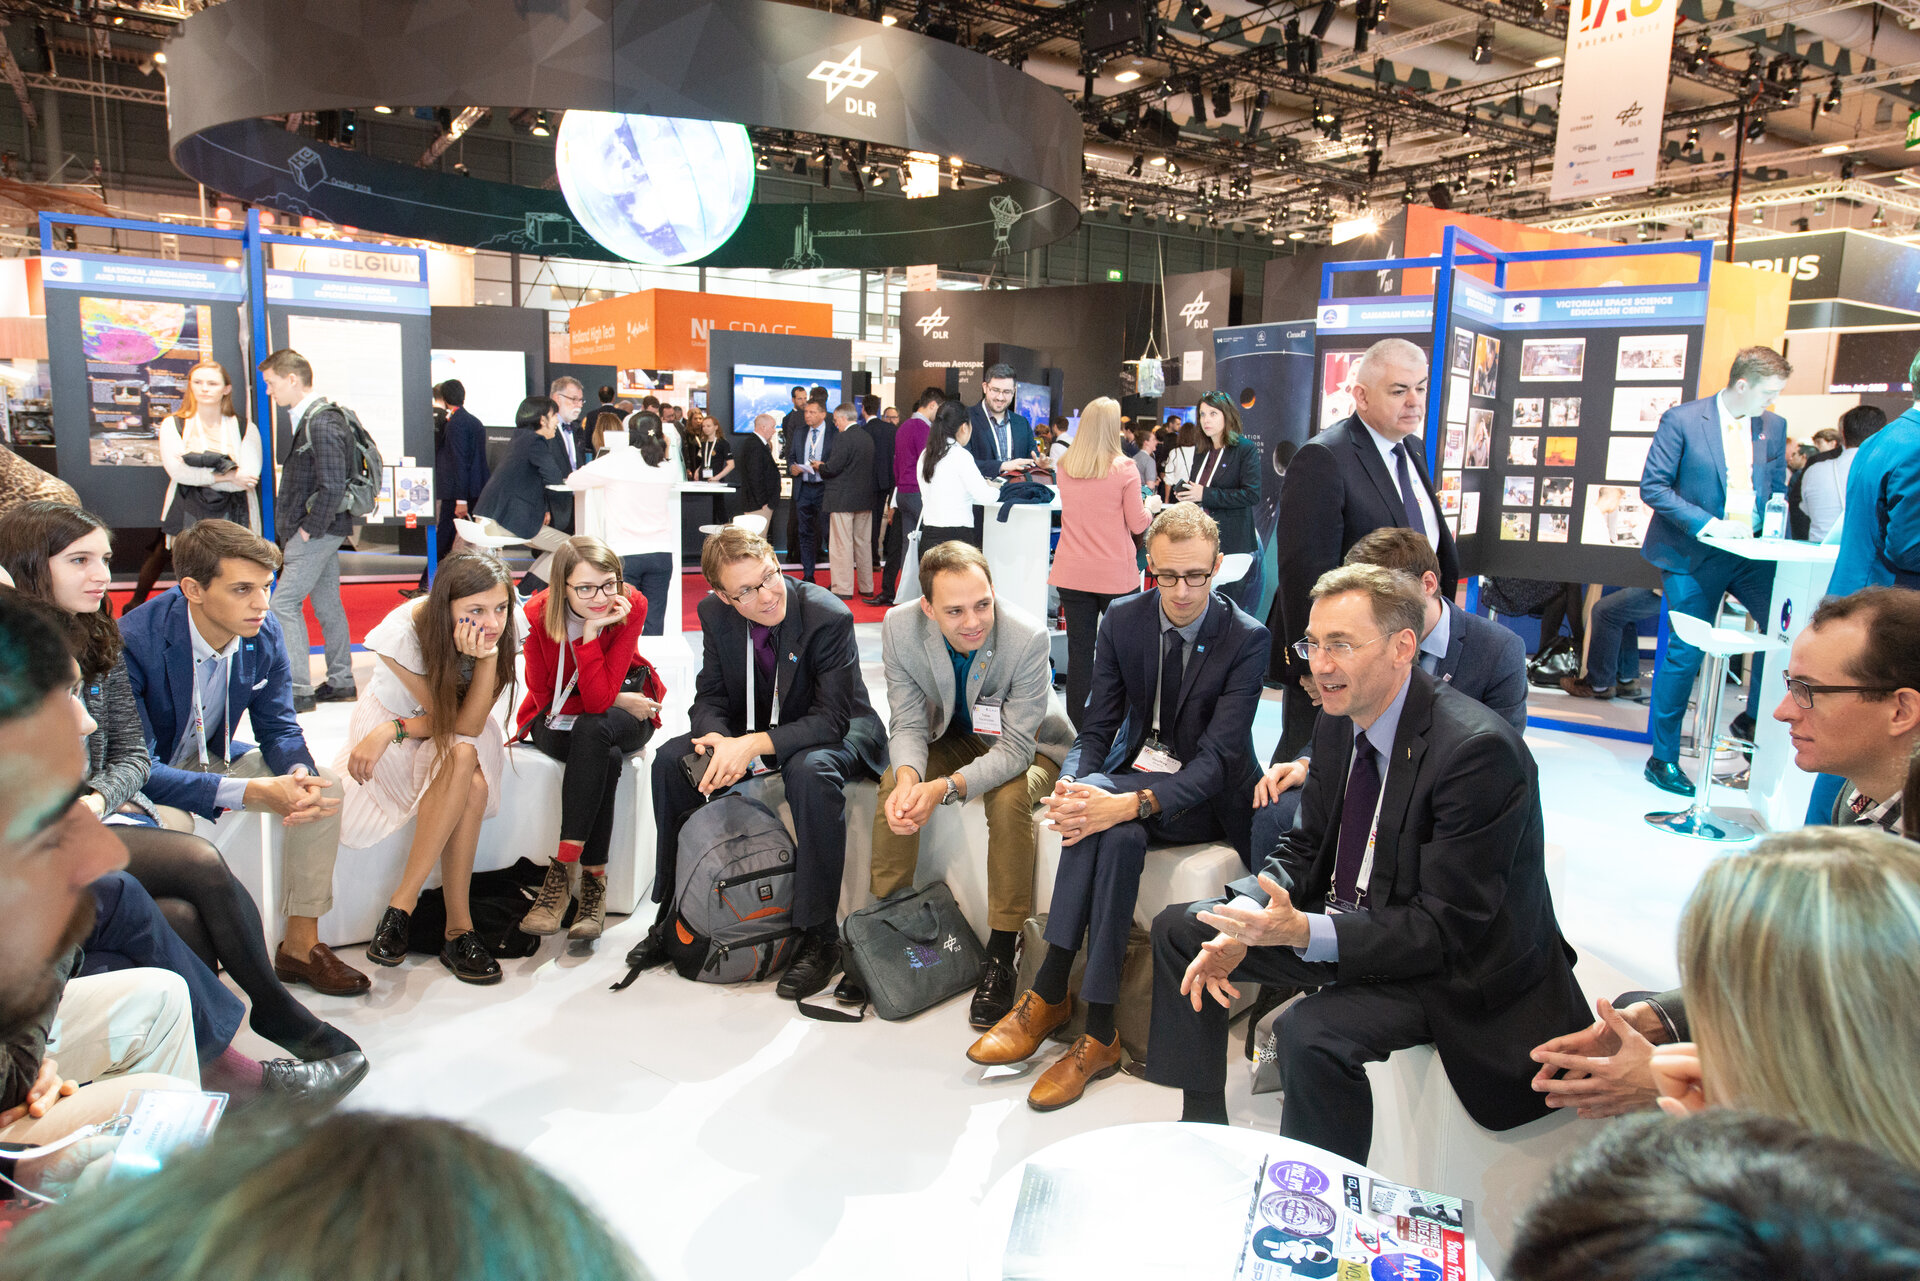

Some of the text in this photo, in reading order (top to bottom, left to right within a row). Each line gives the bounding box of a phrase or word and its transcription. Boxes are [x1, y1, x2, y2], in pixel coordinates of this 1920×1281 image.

[1577, 32, 1623, 49] BREMEN
[845, 96, 877, 118] DLR
[1628, 119, 1642, 127] DLR
[1614, 137, 1639, 146] AIRBUS
[328, 253, 417, 275] BELGIUM
[94, 273, 216, 289] AND SPACE ADMINISTRATION
[102, 265, 207, 281] NATIONAL AERONAUTICS
[1556, 296, 1673, 309] VICTORIAN SPACE SCIENCE
[1360, 311, 1401, 320] CANADIAN
[1402, 309, 1425, 318] SPACE
[1570, 306, 1656, 317] EDUCATION CENTRE
[1194, 319, 1208, 329] DLR
[591, 326, 602, 344] High
[603, 323, 615, 339] Tech
[933, 331, 949, 339] DLR
[1286, 330, 1306, 339] Canada
[923, 360, 984, 369] German Aerospac
[1417, 1220, 1429, 1245] IDEAS
[1430, 1224, 1440, 1248] WHERE
[1446, 1240, 1463, 1263] Bona
[1403, 1256, 1421, 1281] NA
